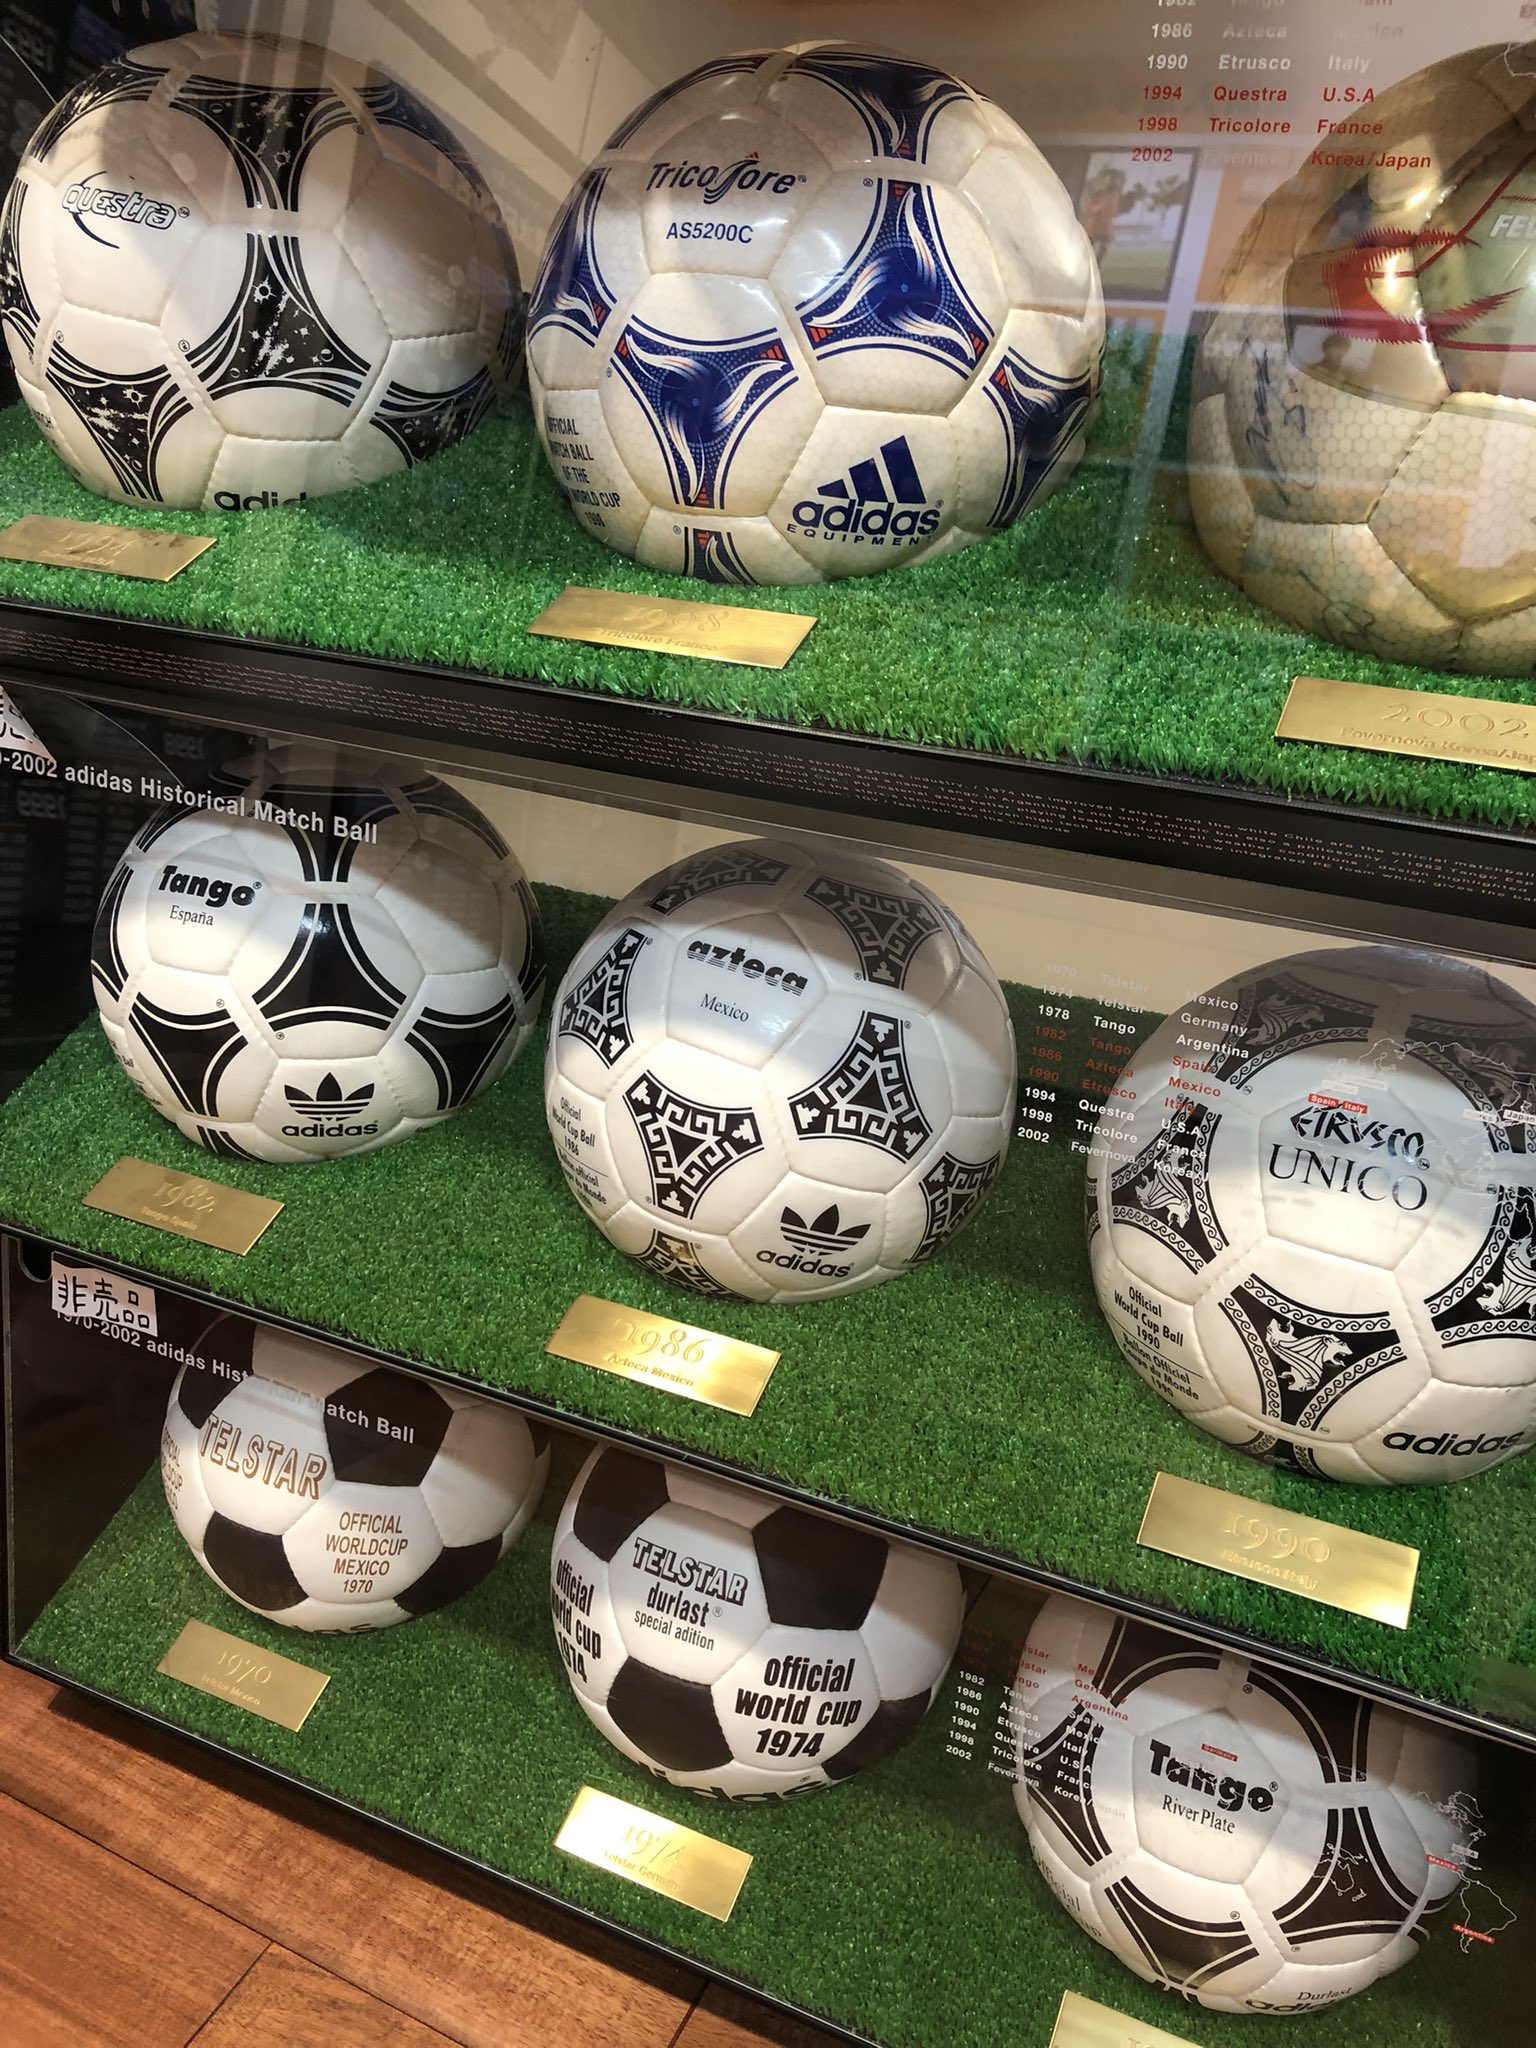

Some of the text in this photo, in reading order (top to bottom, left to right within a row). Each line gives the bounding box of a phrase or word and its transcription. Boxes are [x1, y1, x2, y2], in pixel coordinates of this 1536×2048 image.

[1151, 24, 1287, 39] 1986 Azteca
[1148, 55, 1370, 74] 1990 Etrusco Italy
[1143, 86, 1374, 102] 1994 Questra U.S.A
[1137, 117, 1383, 135] 1998 Tricolore France
[1132, 148, 1173, 162] 2002
[666, 222, 753, 243] AS5200C
[599, 492, 620, 507] CUP
[793, 499, 940, 536] adidas
[65, 765, 378, 844] adidas Historical Match Ball
[159, 865, 255, 908] Tango
[170, 905, 214, 926] España
[687, 940, 809, 997] azteca
[700, 993, 749, 1022] Mexico
[1042, 984, 1073, 999] 1974
[1181, 1012, 1248, 1036] Germany
[1185, 991, 1239, 1011] Mexico
[1038, 1004, 1249, 1059] 1978 Tango Argentina
[1031, 1046, 1221, 1098] 1986 Azteca Mexico
[1089, 1037, 1131, 1056] Tango
[1172, 1055, 1214, 1074] Spain
[1028, 1066, 1137, 1101] 1990 Etrusco
[1025, 1087, 1200, 1136] 1994 Questra U.S.A
[1311, 1095, 1364, 1114] Spain Italy
[282, 1124, 378, 1137] adidas
[580, 1129, 595, 1147] Ball
[1018, 1127, 1136, 1164] 2002 Fevernova
[1022, 1107, 1207, 1160] 1998 Tricolore France
[1269, 1144, 1427, 1210] UNICO
[756, 1250, 851, 1277] adidas
[58, 1274, 150, 1328] 非売品
[1114, 1290, 1184, 1346] World Cup Ball
[1129, 1286, 1162, 1317] Official
[147, 1340, 205, 1370] adidas
[618, 1321, 711, 1364] 1986
[1136, 1326, 1160, 1349] 1990
[608, 1352, 694, 1387] Azteca Mexico
[1153, 1356, 1190, 1384] Officiel
[1164, 1374, 1199, 1400] Monde
[377, 1417, 414, 1444] Ball
[1382, 1432, 1525, 1456] adidas
[200, 1412, 327, 1500] TELSTAR
[339, 1511, 403, 1534] OFFICIAL
[1224, 1512, 1331, 1563] 1990
[326, 1534, 408, 1556] WORLDCUP
[333, 1558, 390, 1575] MEXICO
[632, 1537, 748, 1607] TELSTAR
[342, 1579, 373, 1593] 1970
[556, 1558, 594, 1617] official
[647, 1581, 709, 1628] durlast
[575, 1625, 601, 1660] cup
[634, 1610, 714, 1650] special adition
[218, 1652, 272, 1684] 1970
[764, 1655, 856, 1692] official
[959, 1670, 985, 1686] 1982
[735, 1688, 862, 1727] world cup
[956, 1686, 982, 1701] 1986
[999, 1701, 1039, 1722] Azteca
[1072, 1695, 1129, 1721] Argentina
[755, 1728, 825, 1758] 1974
[951, 1716, 977, 1731] 1994
[995, 1731, 1040, 1754] Questra
[954, 1701, 1088, 1756] 1990 Etrusco Italy
[946, 1745, 1040, 1788] 2002 Fevernova
[949, 1730, 974, 1746] 1998
[992, 1746, 1042, 1771] Tricolore
[1150, 1739, 1274, 1812] Tango
[1162, 1794, 1236, 1834] River Plate
